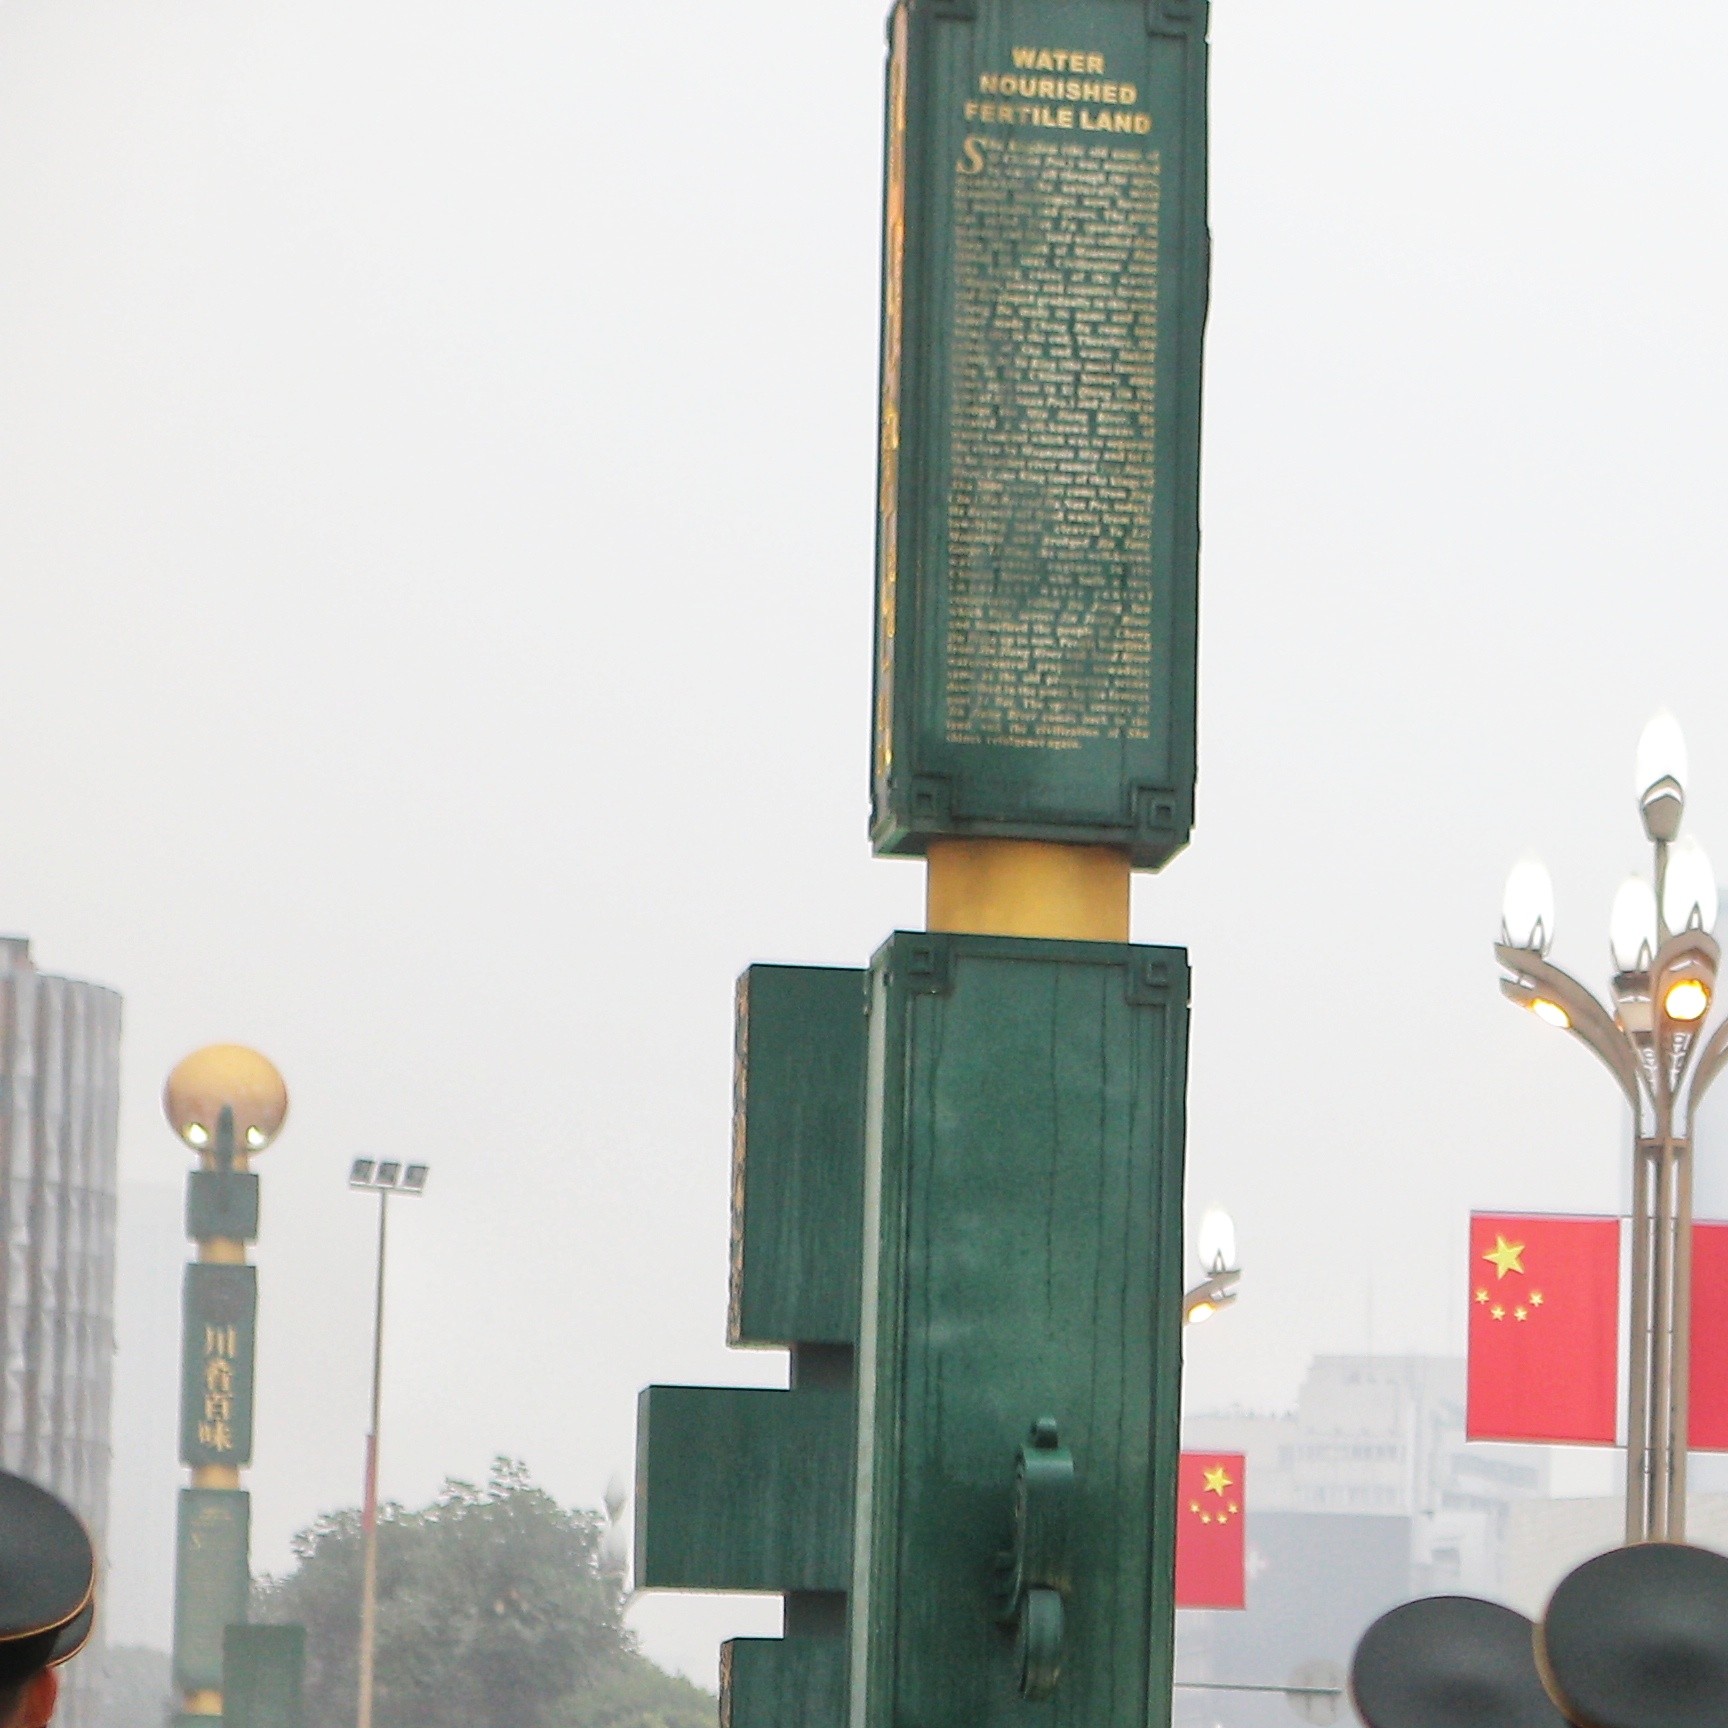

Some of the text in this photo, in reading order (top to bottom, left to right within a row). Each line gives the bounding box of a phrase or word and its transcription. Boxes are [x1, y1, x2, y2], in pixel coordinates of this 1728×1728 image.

[1011, 47, 1105, 74] WATER
[979, 73, 1138, 105] NOURISHED
[963, 100, 1152, 135] FERTILE LAND
